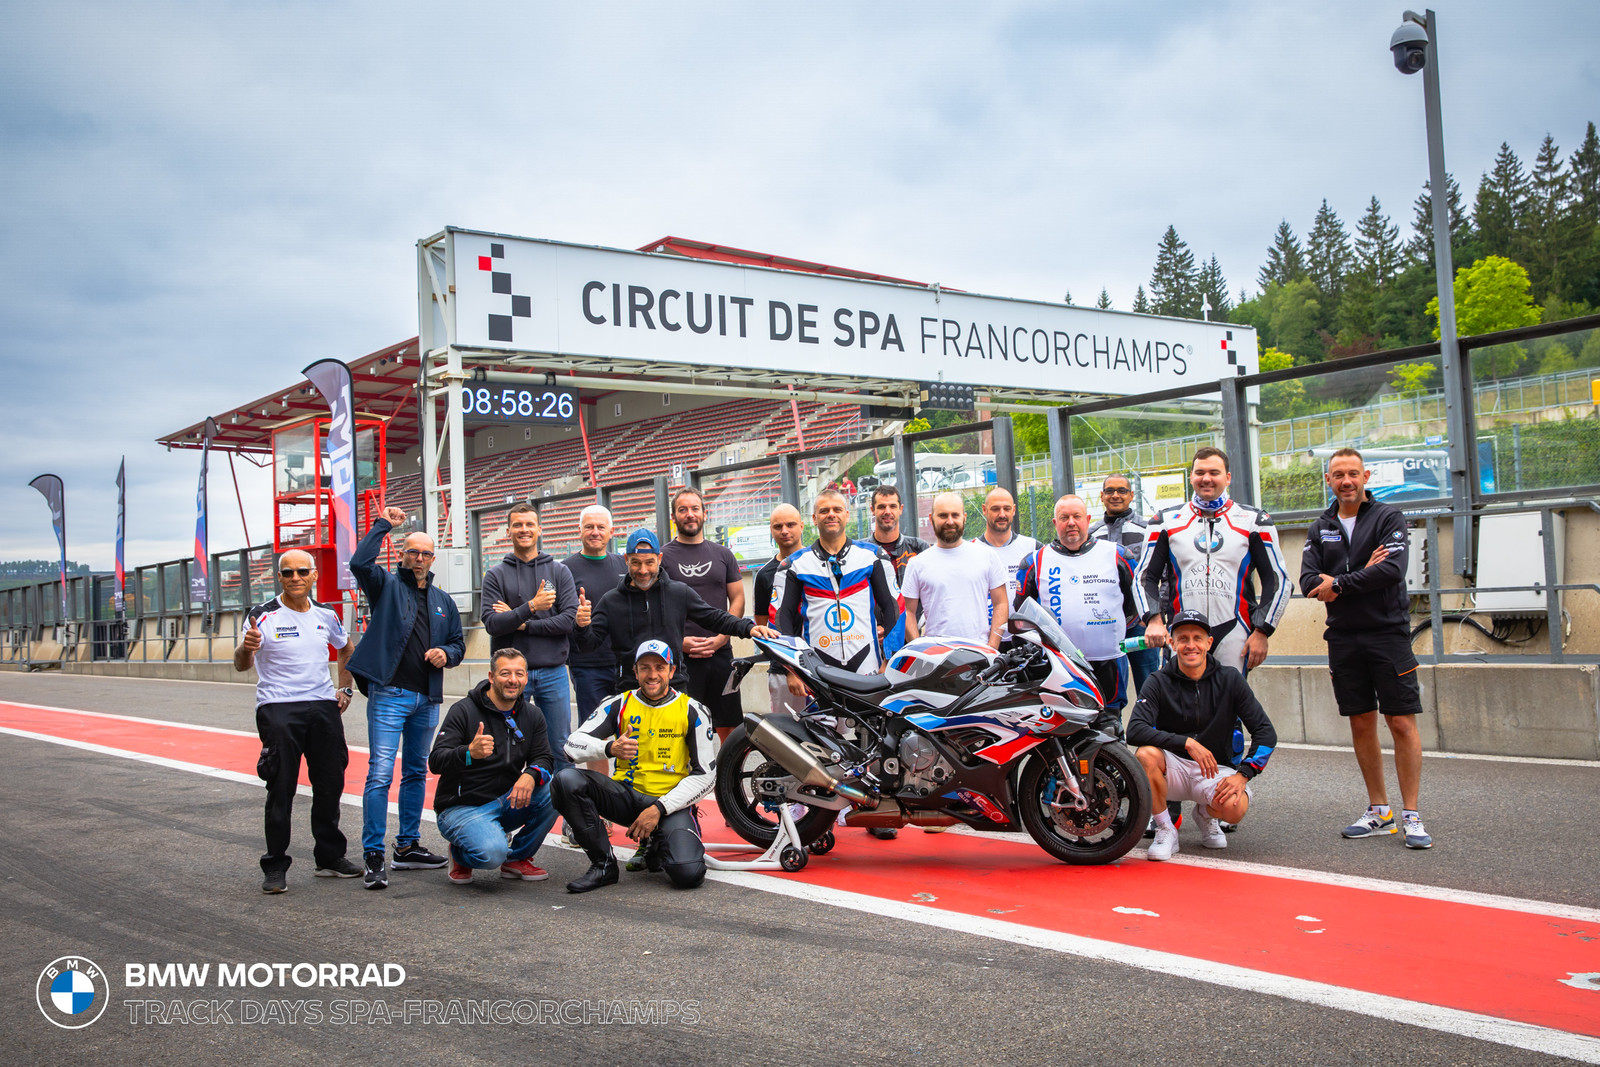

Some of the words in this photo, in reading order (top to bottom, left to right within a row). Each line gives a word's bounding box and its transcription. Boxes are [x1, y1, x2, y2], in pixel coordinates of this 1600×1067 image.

[582, 281, 754, 338] CIRCUIT
[768, 300, 820, 344] DE
[833, 307, 905, 352] SPA
[462, 387, 574, 419] 08:58:26
[1184, 578, 1231, 591] EVASION
